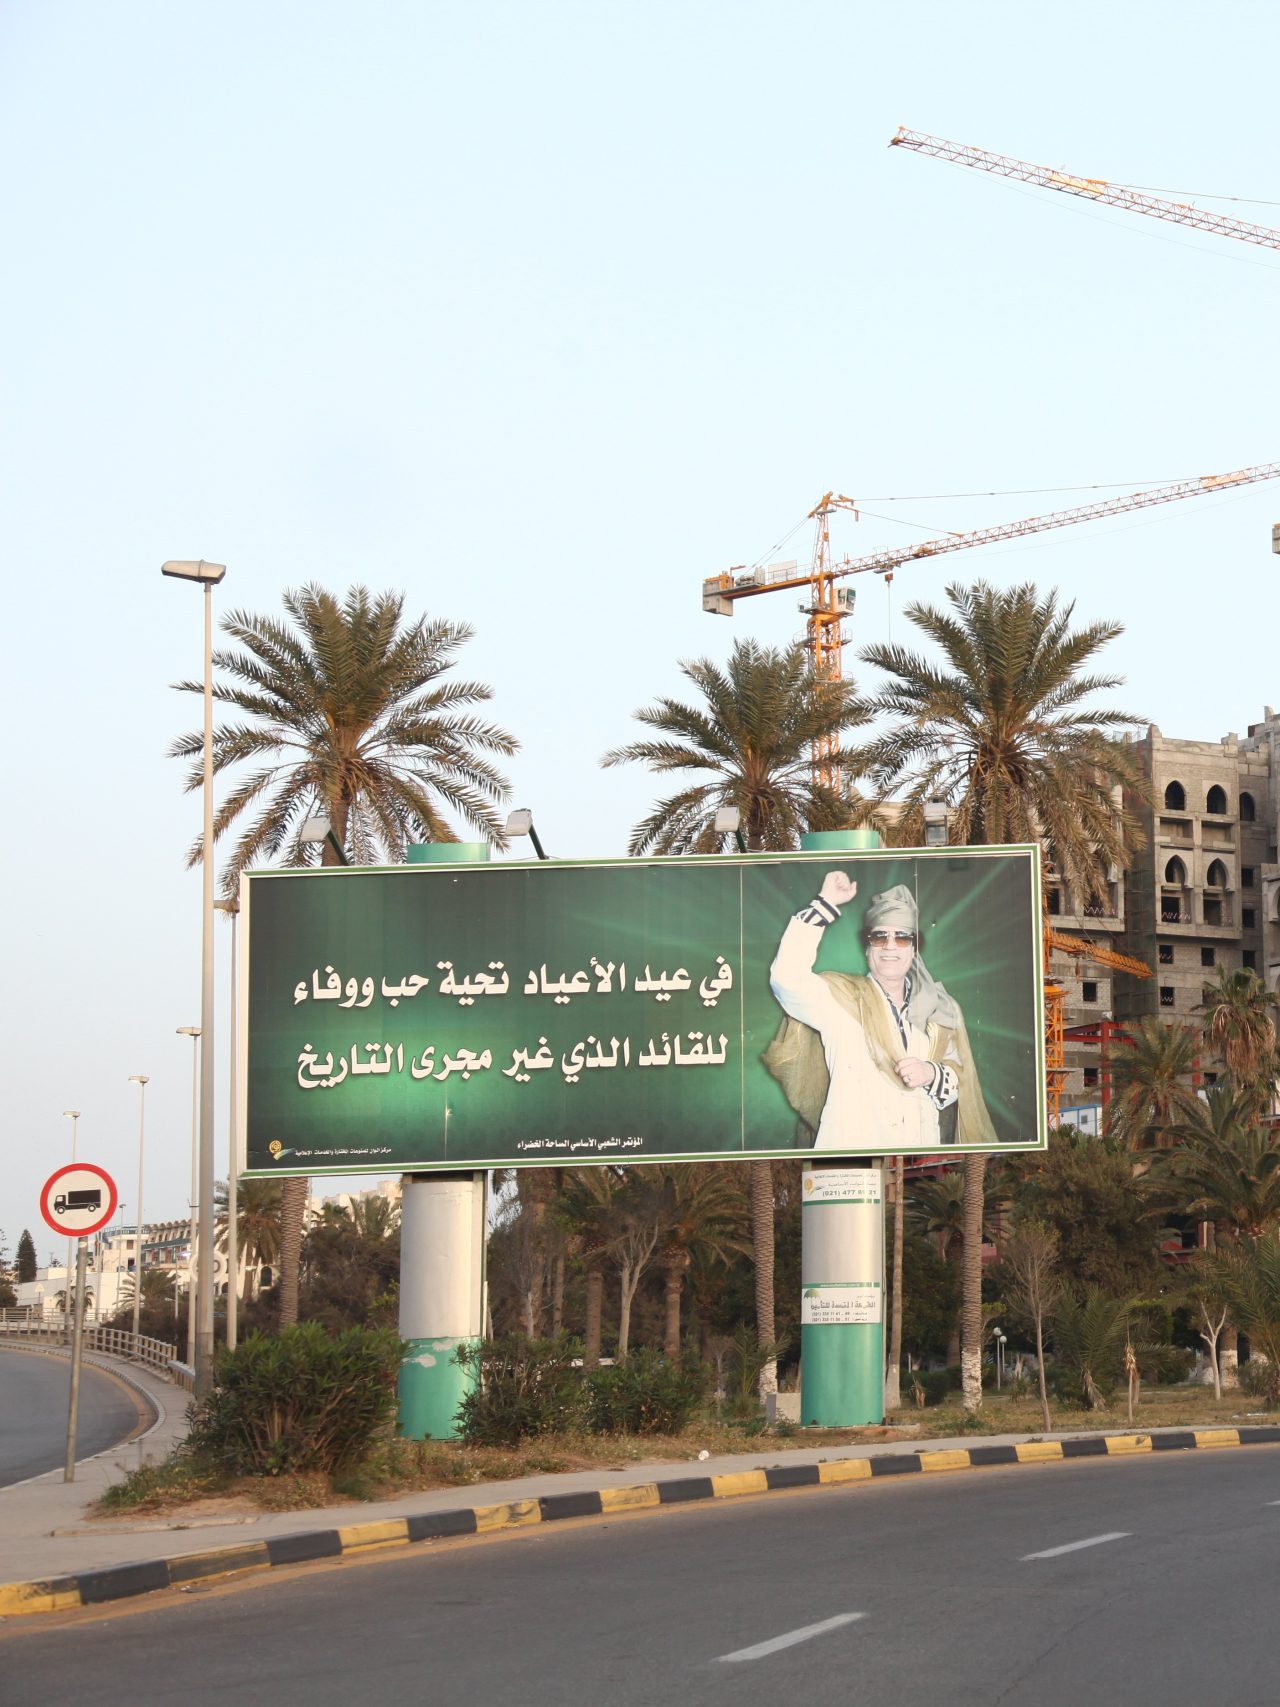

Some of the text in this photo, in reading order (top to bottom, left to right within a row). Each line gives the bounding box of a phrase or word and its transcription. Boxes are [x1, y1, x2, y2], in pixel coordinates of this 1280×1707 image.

[294, 955, 733, 1008] في عيد الأعياد تحية حب ووفاء
[297, 1031, 729, 1089] للقائد الذي غير مجرى التاريخ
[517, 1139, 544, 1150] الخضراء
[545, 1138, 570, 1148] الساحة
[597, 1137, 620, 1151] الشعبي
[621, 1136, 643, 1148] المؤتمر
